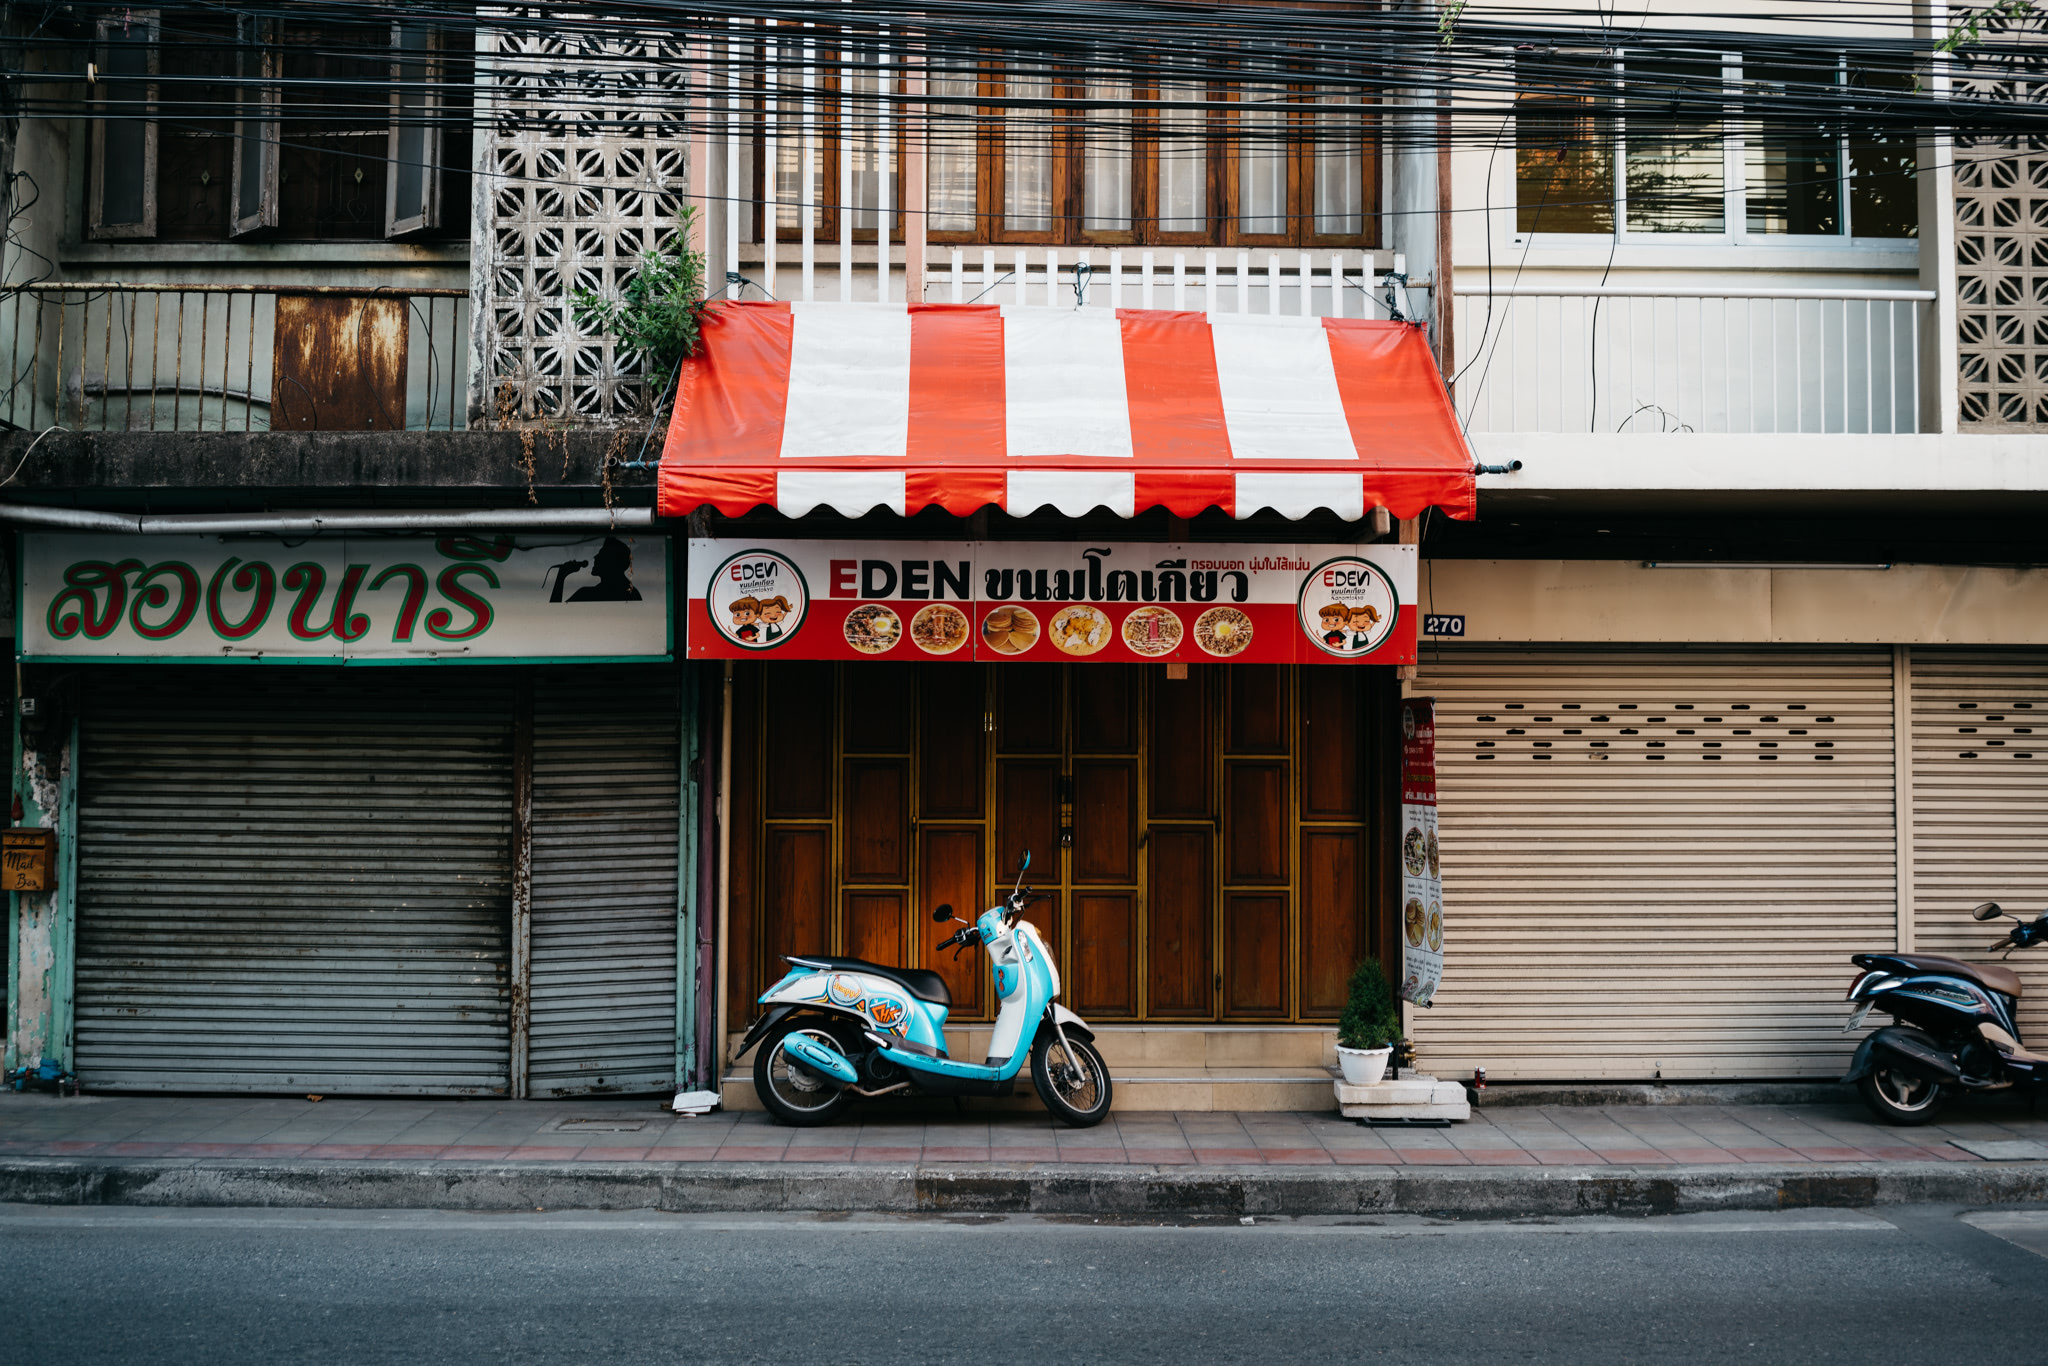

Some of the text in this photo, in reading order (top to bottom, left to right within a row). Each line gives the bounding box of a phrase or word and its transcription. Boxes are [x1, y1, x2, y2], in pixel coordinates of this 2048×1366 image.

[731, 561, 778, 581] EDEN
[829, 547, 1249, 602] EDEN ขนมโตเกียว
[1191, 557, 1310, 574] กรอบนอก นุ่มในไส้แน่น
[1324, 570, 1370, 587] EDEN
[46, 535, 515, 643] สองนารี
[1427, 617, 1462, 633] 270
[4, 851, 36, 871] Mail
